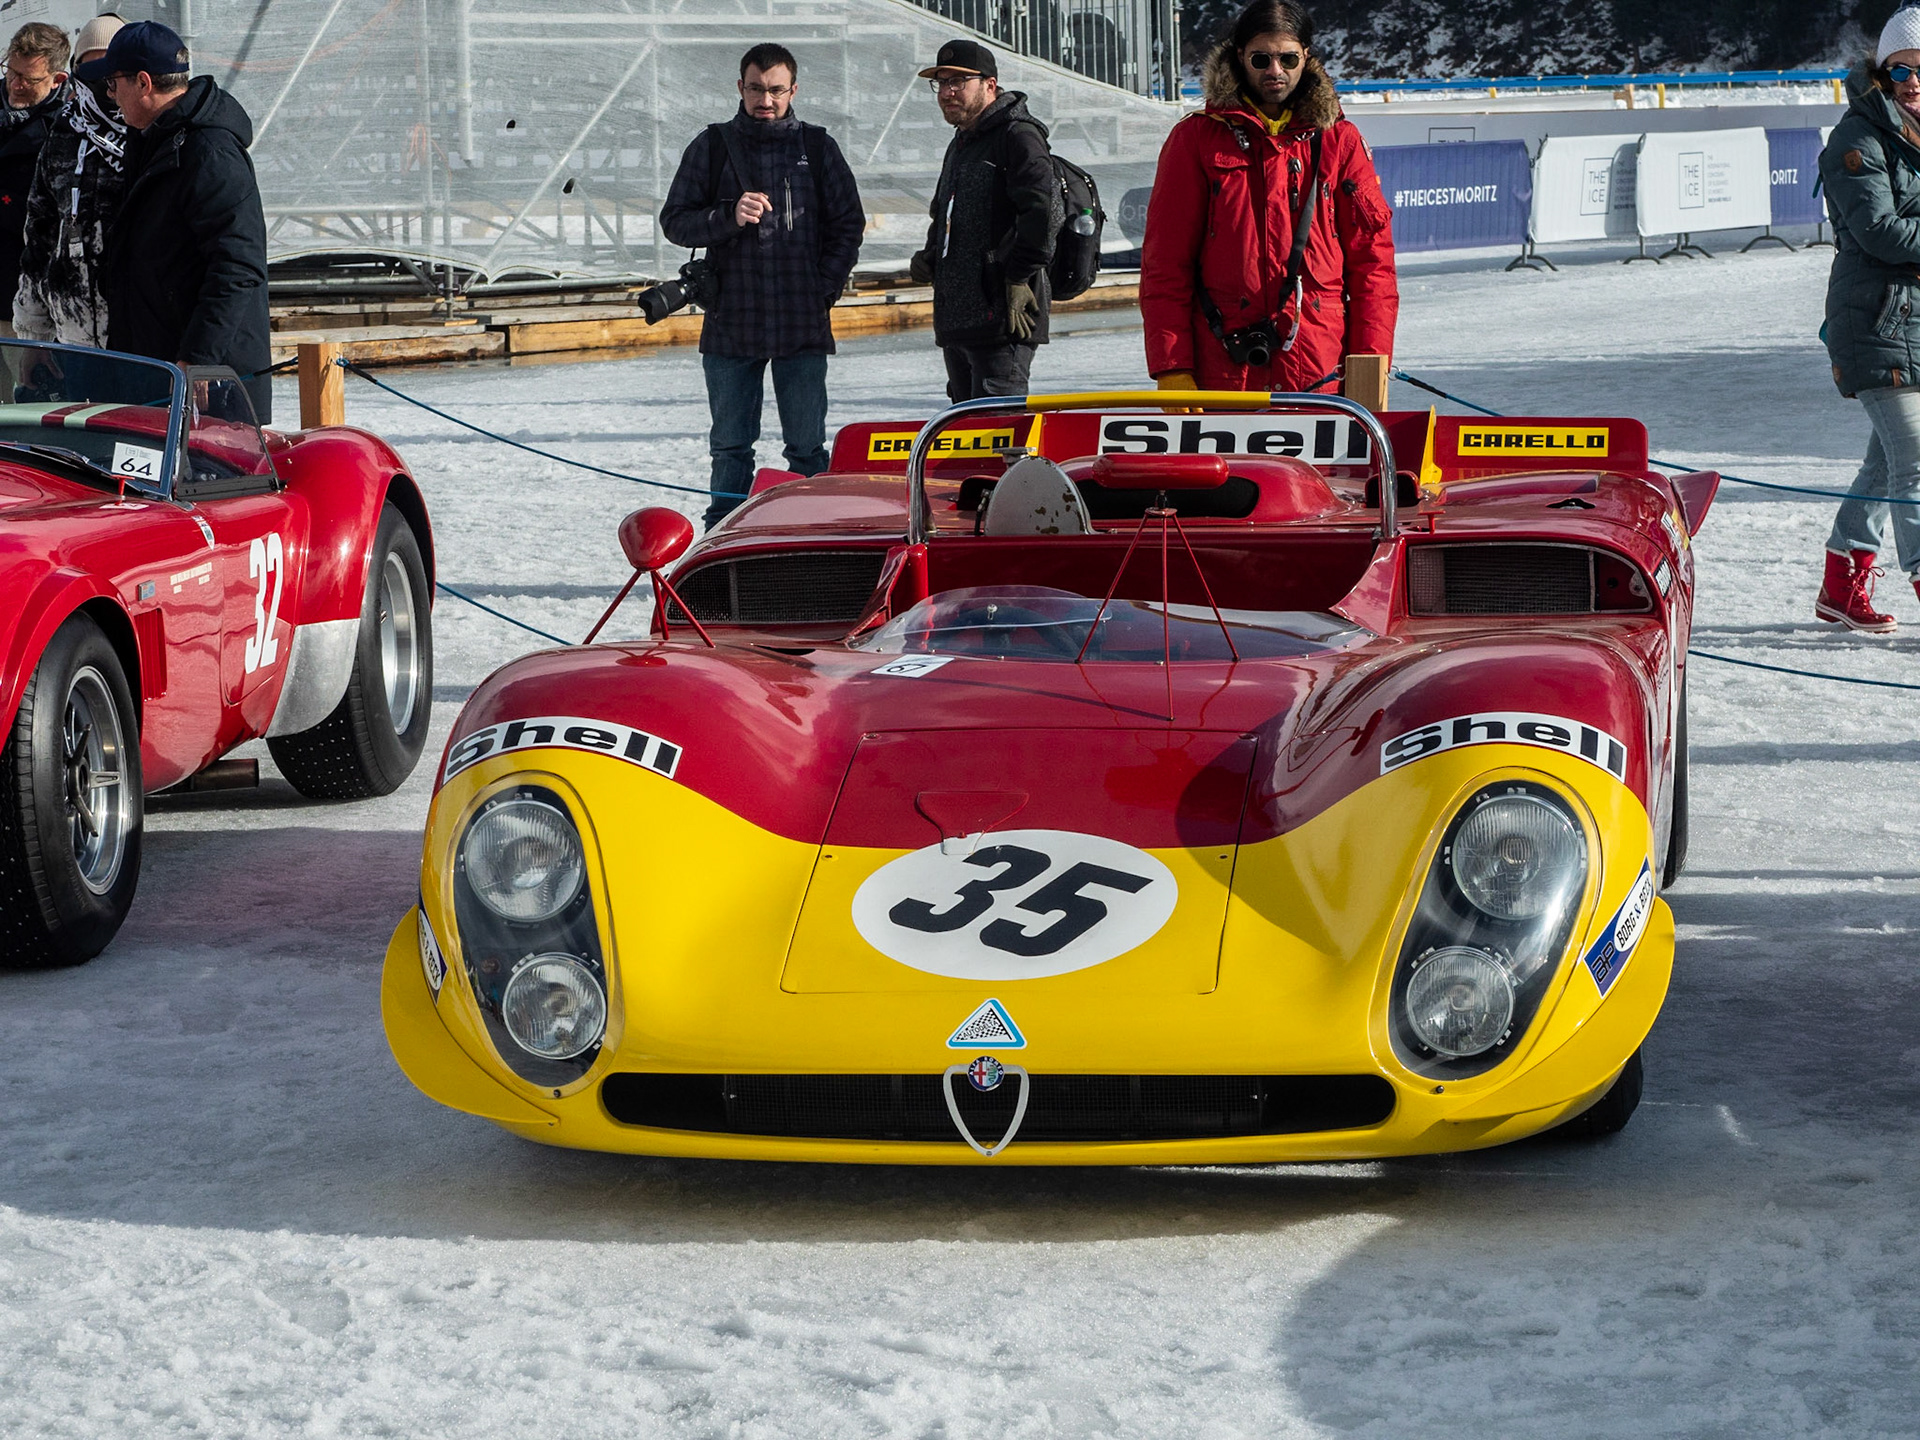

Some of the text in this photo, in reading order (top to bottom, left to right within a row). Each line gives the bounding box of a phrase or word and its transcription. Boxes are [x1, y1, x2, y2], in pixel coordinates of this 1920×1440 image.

[1588, 170, 1607, 184] THE
[1683, 164, 1700, 179] THE
[1769, 168, 1798, 185] ORITZ
[1394, 185, 1498, 208] #THEICESTMORITZ
[1588, 188, 1606, 203] ICE
[1684, 182, 1700, 197] ICE
[873, 435, 1010, 453] CAELLO
[1102, 420, 1368, 458] Shell
[1463, 433, 1605, 449] CARELLO
[120, 457, 153, 477] 64
[244, 532, 284, 675] 32
[886, 663, 927, 674] 67
[447, 721, 678, 776] Shell
[1384, 717, 1624, 777] Shell
[888, 844, 1155, 957] 35
[1616, 912, 1636, 948] BORG
[963, 1020, 999, 1038] AUTODELTA
